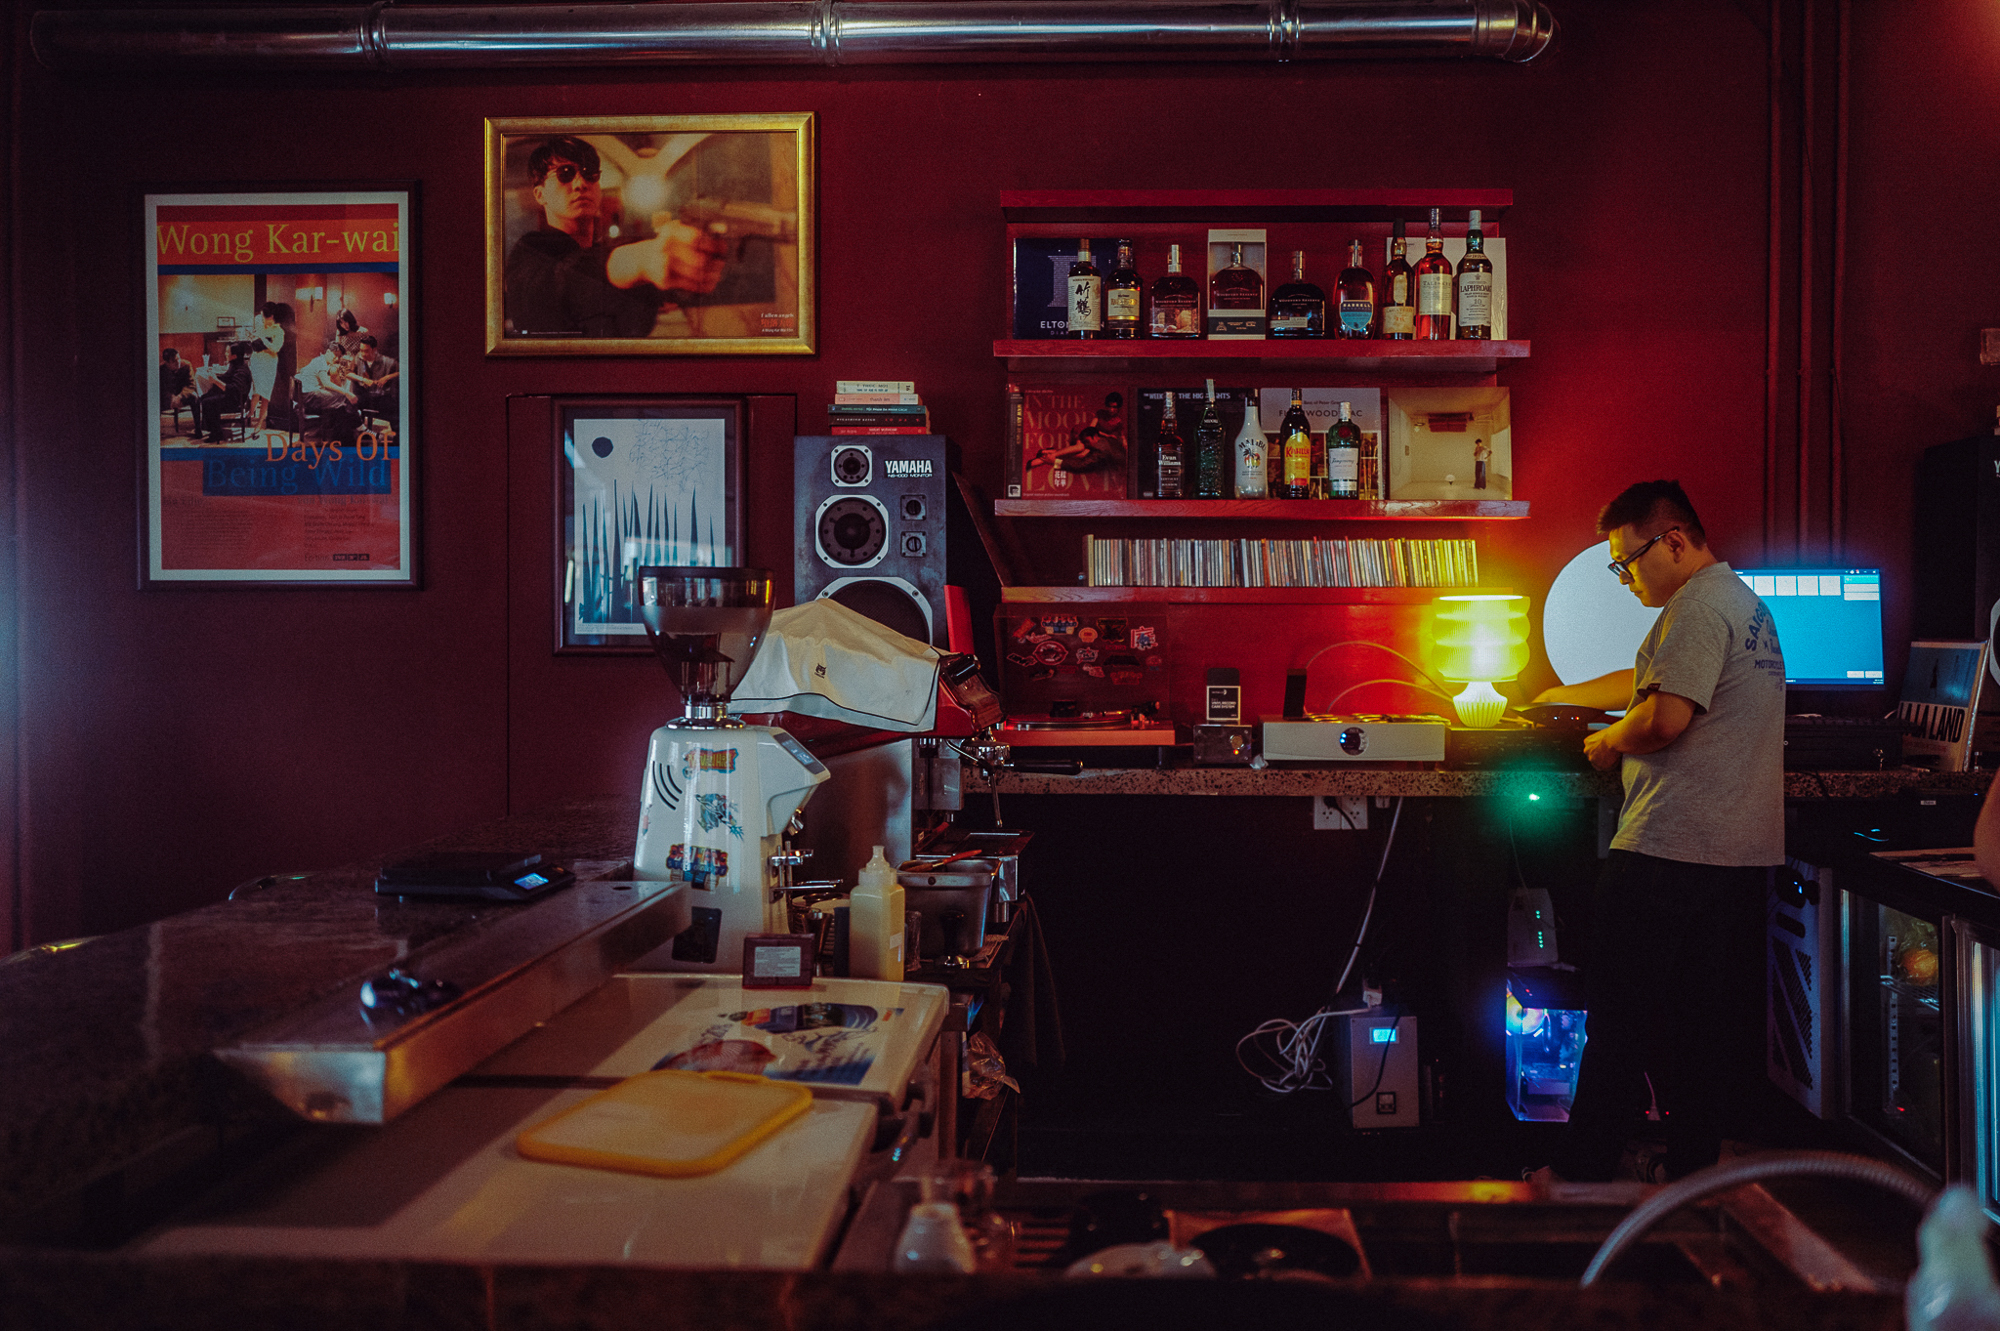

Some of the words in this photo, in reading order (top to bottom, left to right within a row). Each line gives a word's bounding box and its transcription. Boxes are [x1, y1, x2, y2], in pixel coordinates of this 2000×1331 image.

[157, 224, 253, 263] Wong
[266, 221, 398, 253] Kar-wai
[1025, 395, 1043, 409] IN
[1046, 395, 1086, 409] THE
[1178, 392, 1190, 400] THE
[1278, 409, 1336, 418] FLWOOD
[264, 431, 343, 471] Days
[354, 431, 396, 462] Of
[1026, 432, 1072, 451] FOR
[884, 459, 933, 474] YAMAHA
[206, 460, 299, 496] Being
[313, 457, 387, 487] Wild
[1928, 705, 1965, 743] LAND
